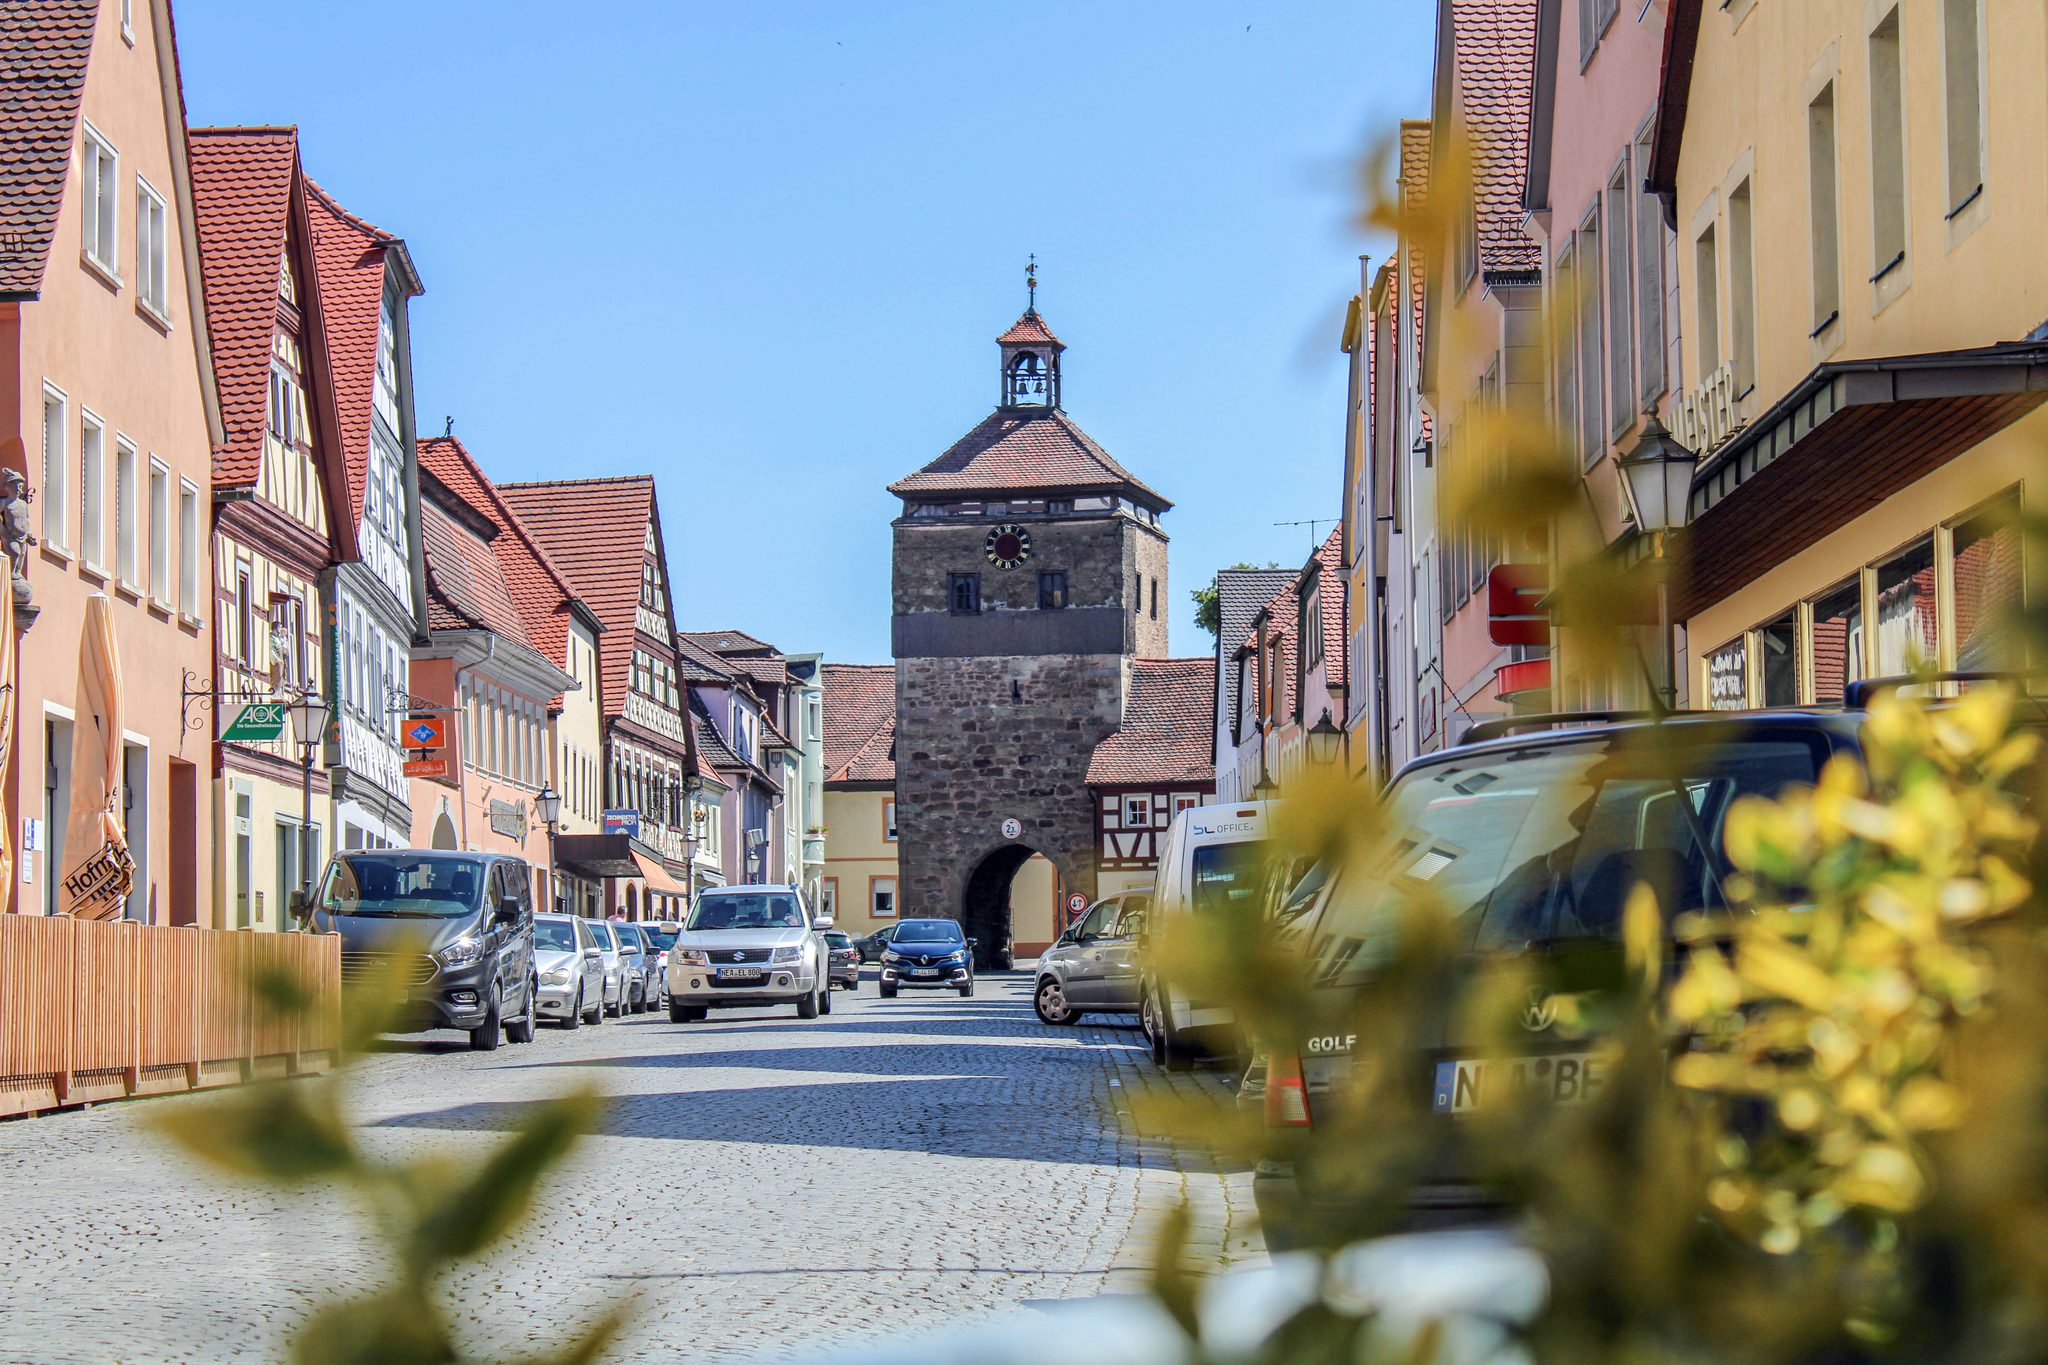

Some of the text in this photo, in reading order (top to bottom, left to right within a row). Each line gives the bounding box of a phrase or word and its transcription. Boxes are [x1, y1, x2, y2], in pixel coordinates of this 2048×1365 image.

[239, 706, 281, 723] AOK
[1308, 1034, 1357, 1052] GOLF
[1438, 1094, 1447, 1105] D
